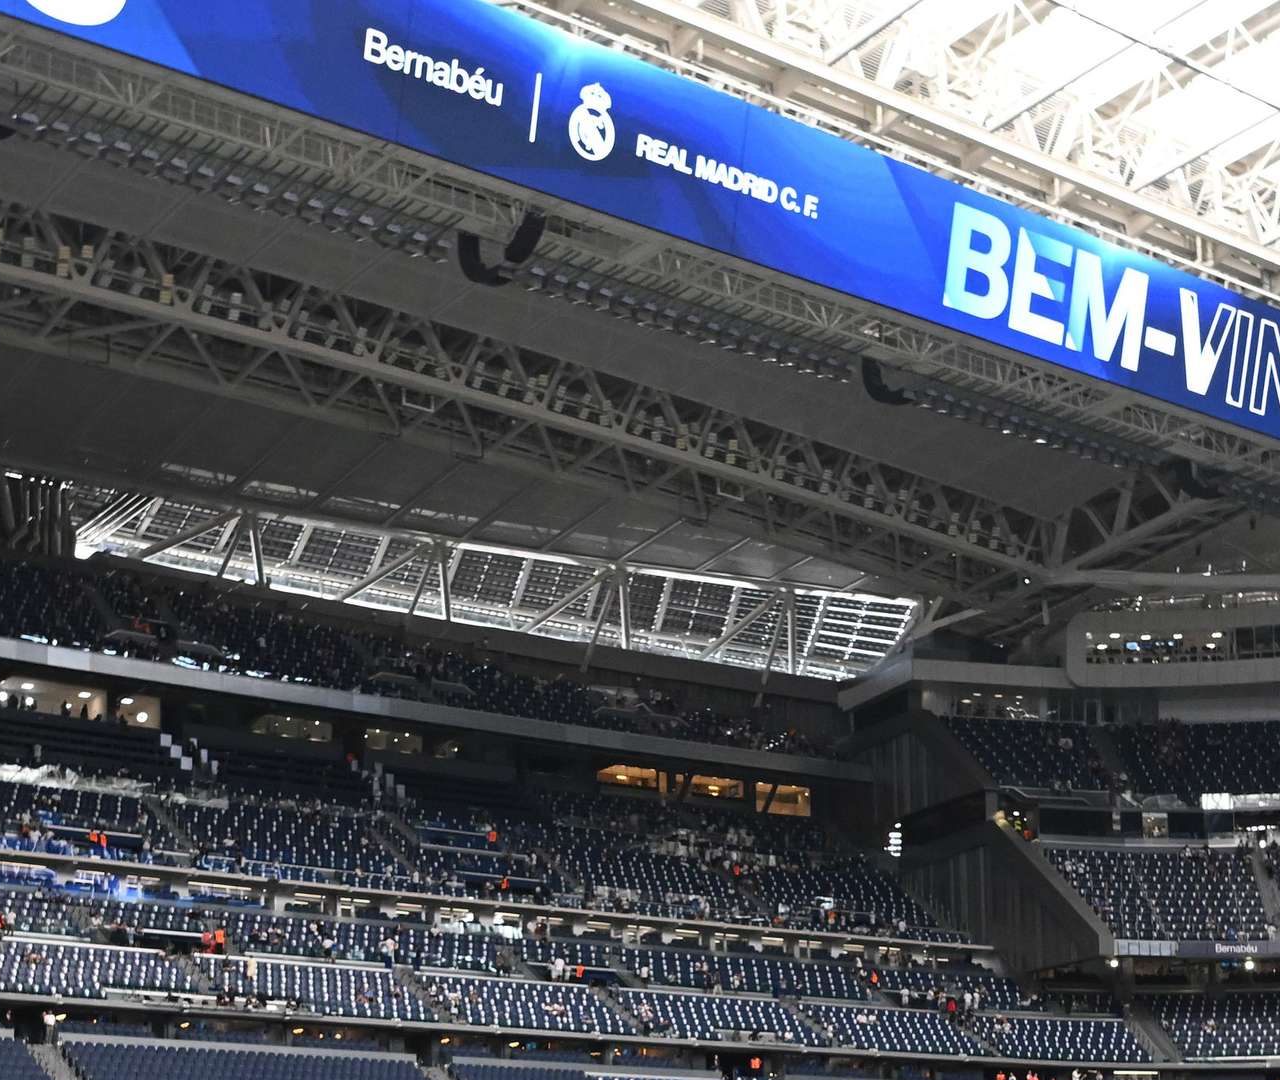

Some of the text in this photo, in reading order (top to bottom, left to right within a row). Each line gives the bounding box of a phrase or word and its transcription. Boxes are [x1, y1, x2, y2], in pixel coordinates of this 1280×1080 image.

[363, 27, 503, 107] Bernabéu
[635, 133, 819, 219] REAL MADRID C. F.
